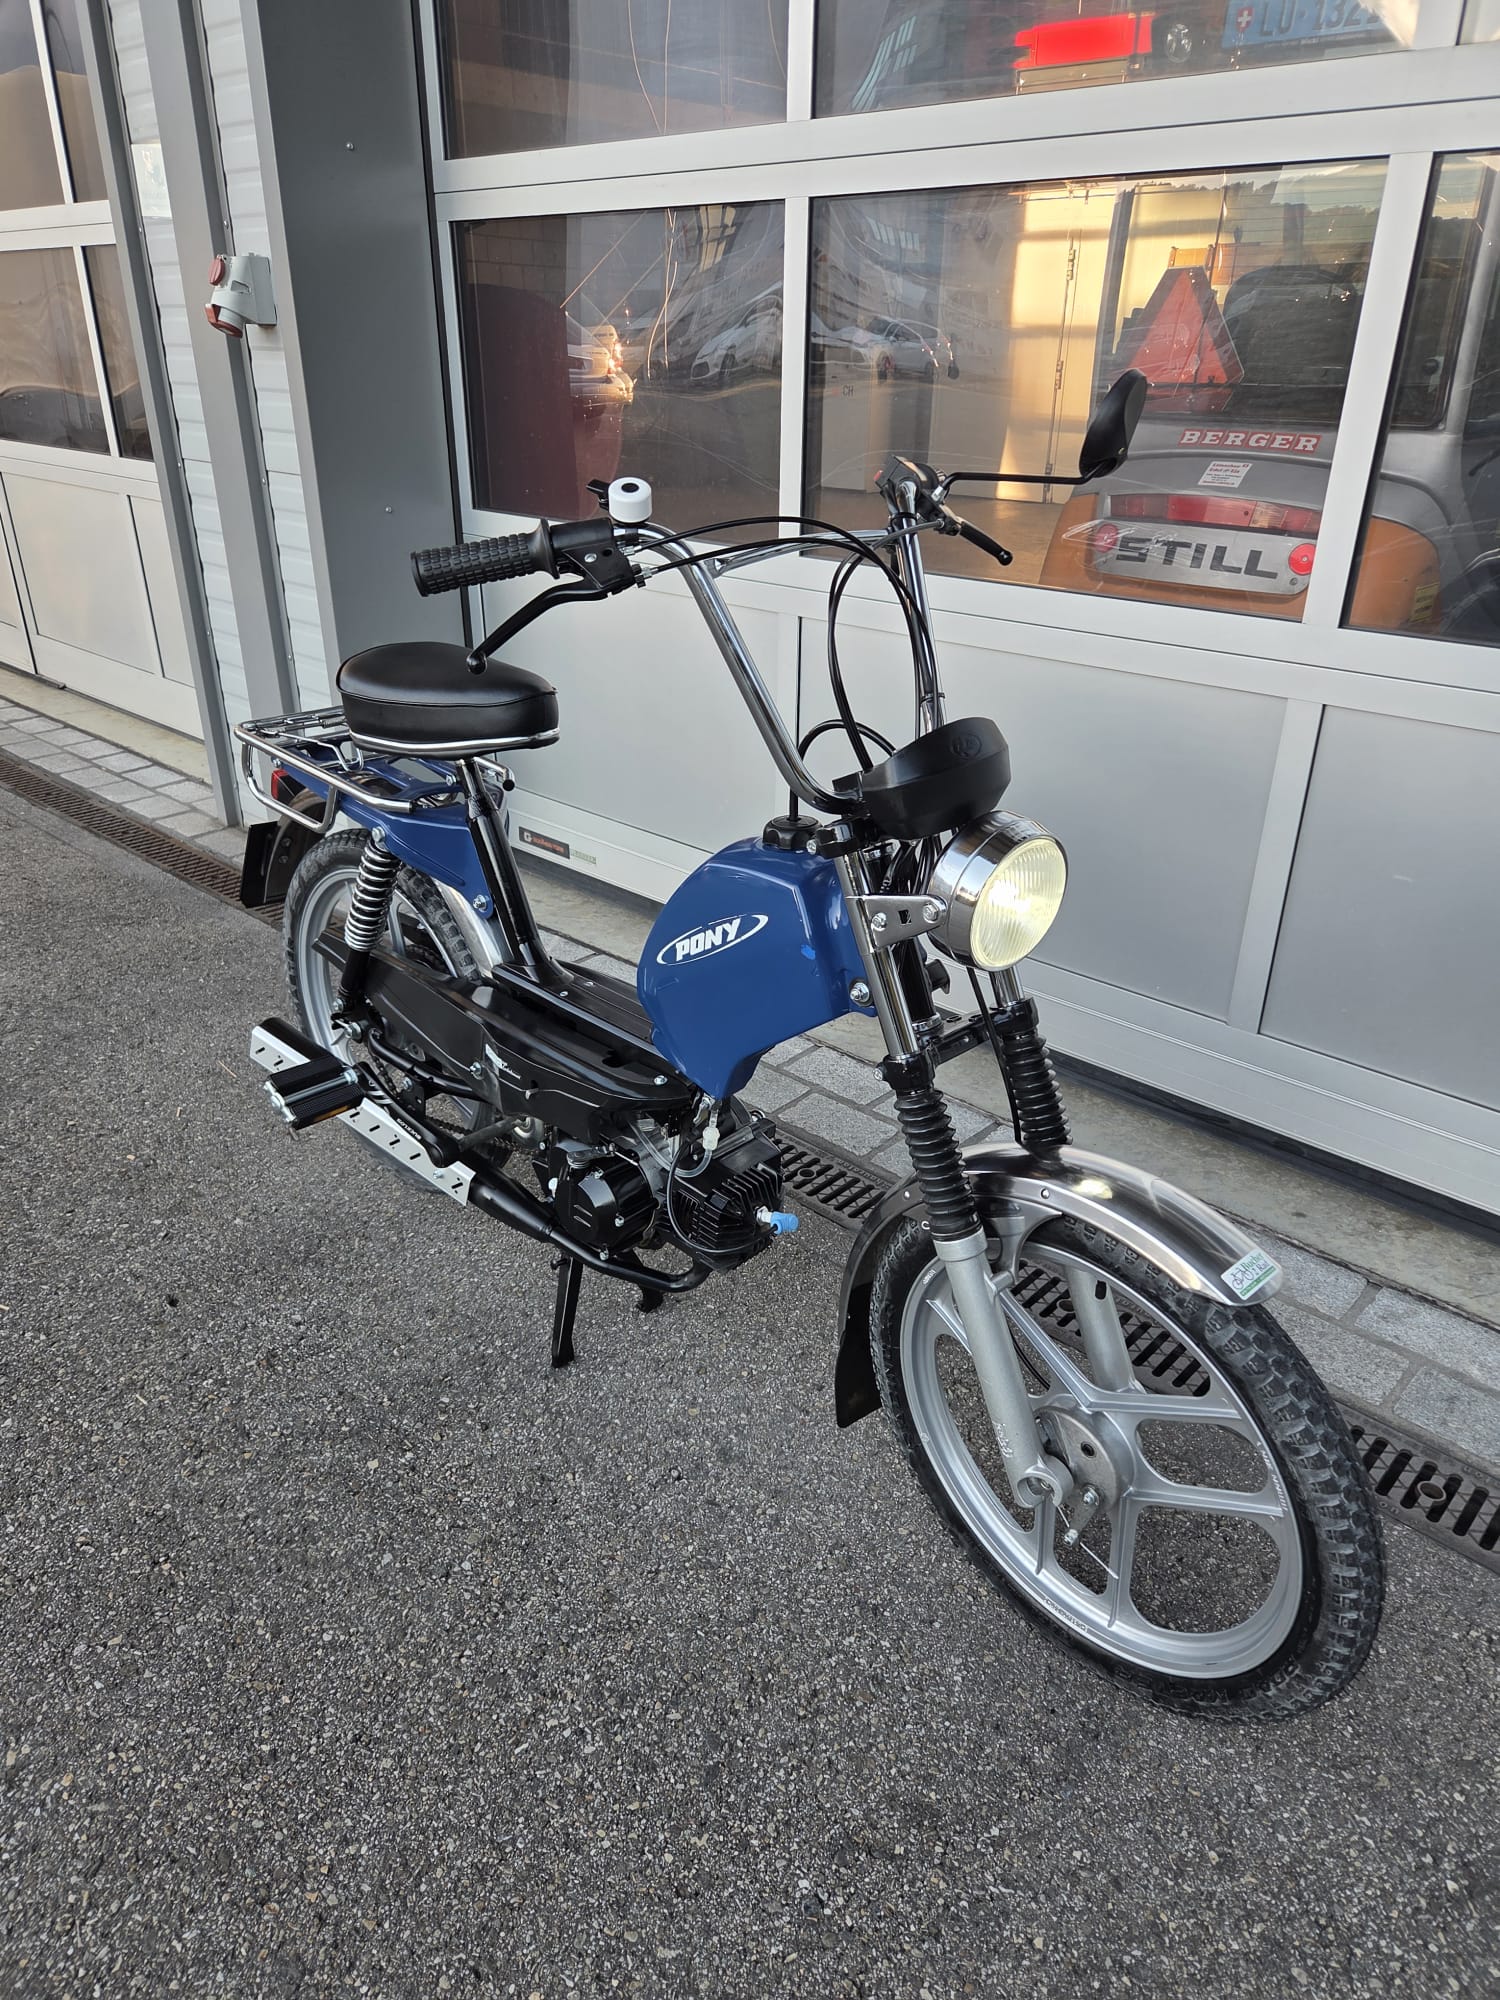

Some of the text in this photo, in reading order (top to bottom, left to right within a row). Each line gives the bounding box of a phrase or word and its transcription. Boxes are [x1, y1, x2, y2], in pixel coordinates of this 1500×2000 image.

[1180, 430, 1317, 451] BERGER
[1115, 536, 1279, 580] STILL
[675, 918, 741, 961] PONY
